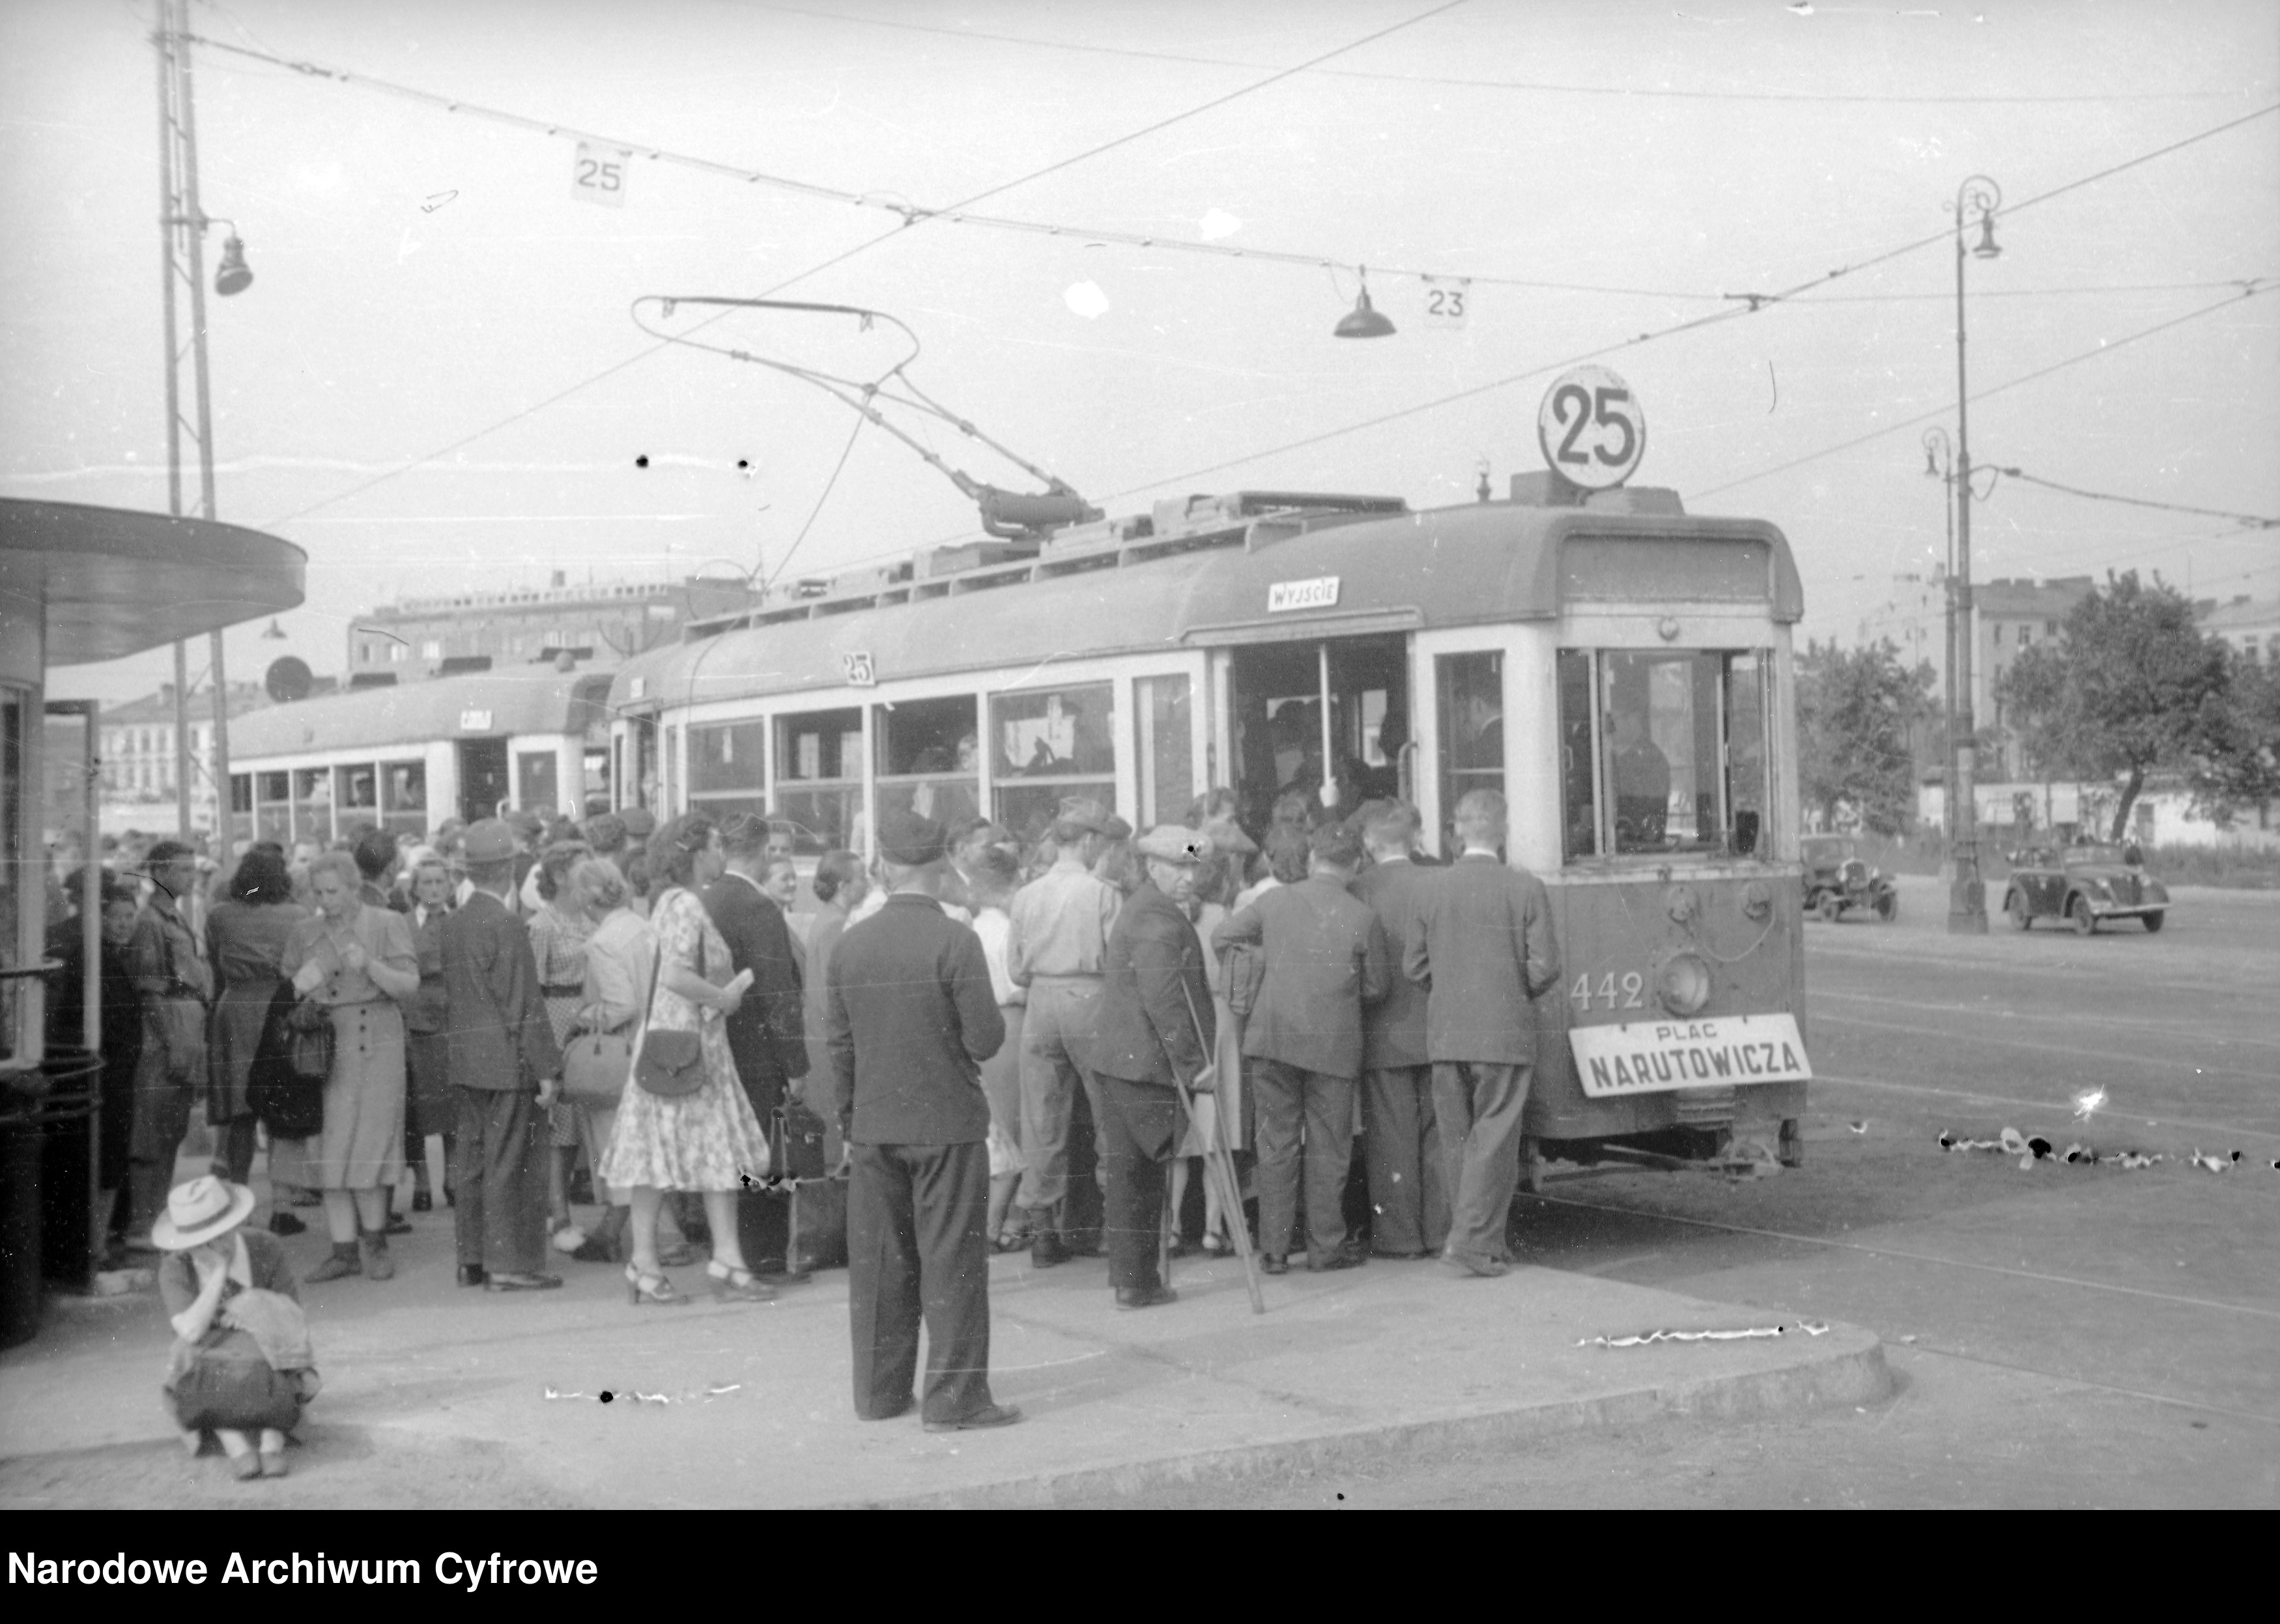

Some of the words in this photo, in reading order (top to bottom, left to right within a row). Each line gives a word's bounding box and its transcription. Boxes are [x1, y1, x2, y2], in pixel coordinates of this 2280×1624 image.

[578, 160, 621, 192] 25
[1429, 291, 1464, 317] 23
[1552, 384, 1636, 467] 25
[843, 654, 870, 681] 25
[1571, 971, 1644, 1010] 442
[1655, 1023, 1718, 1042] PLAC
[1589, 1043, 1802, 1089] NARUTOWICZA
